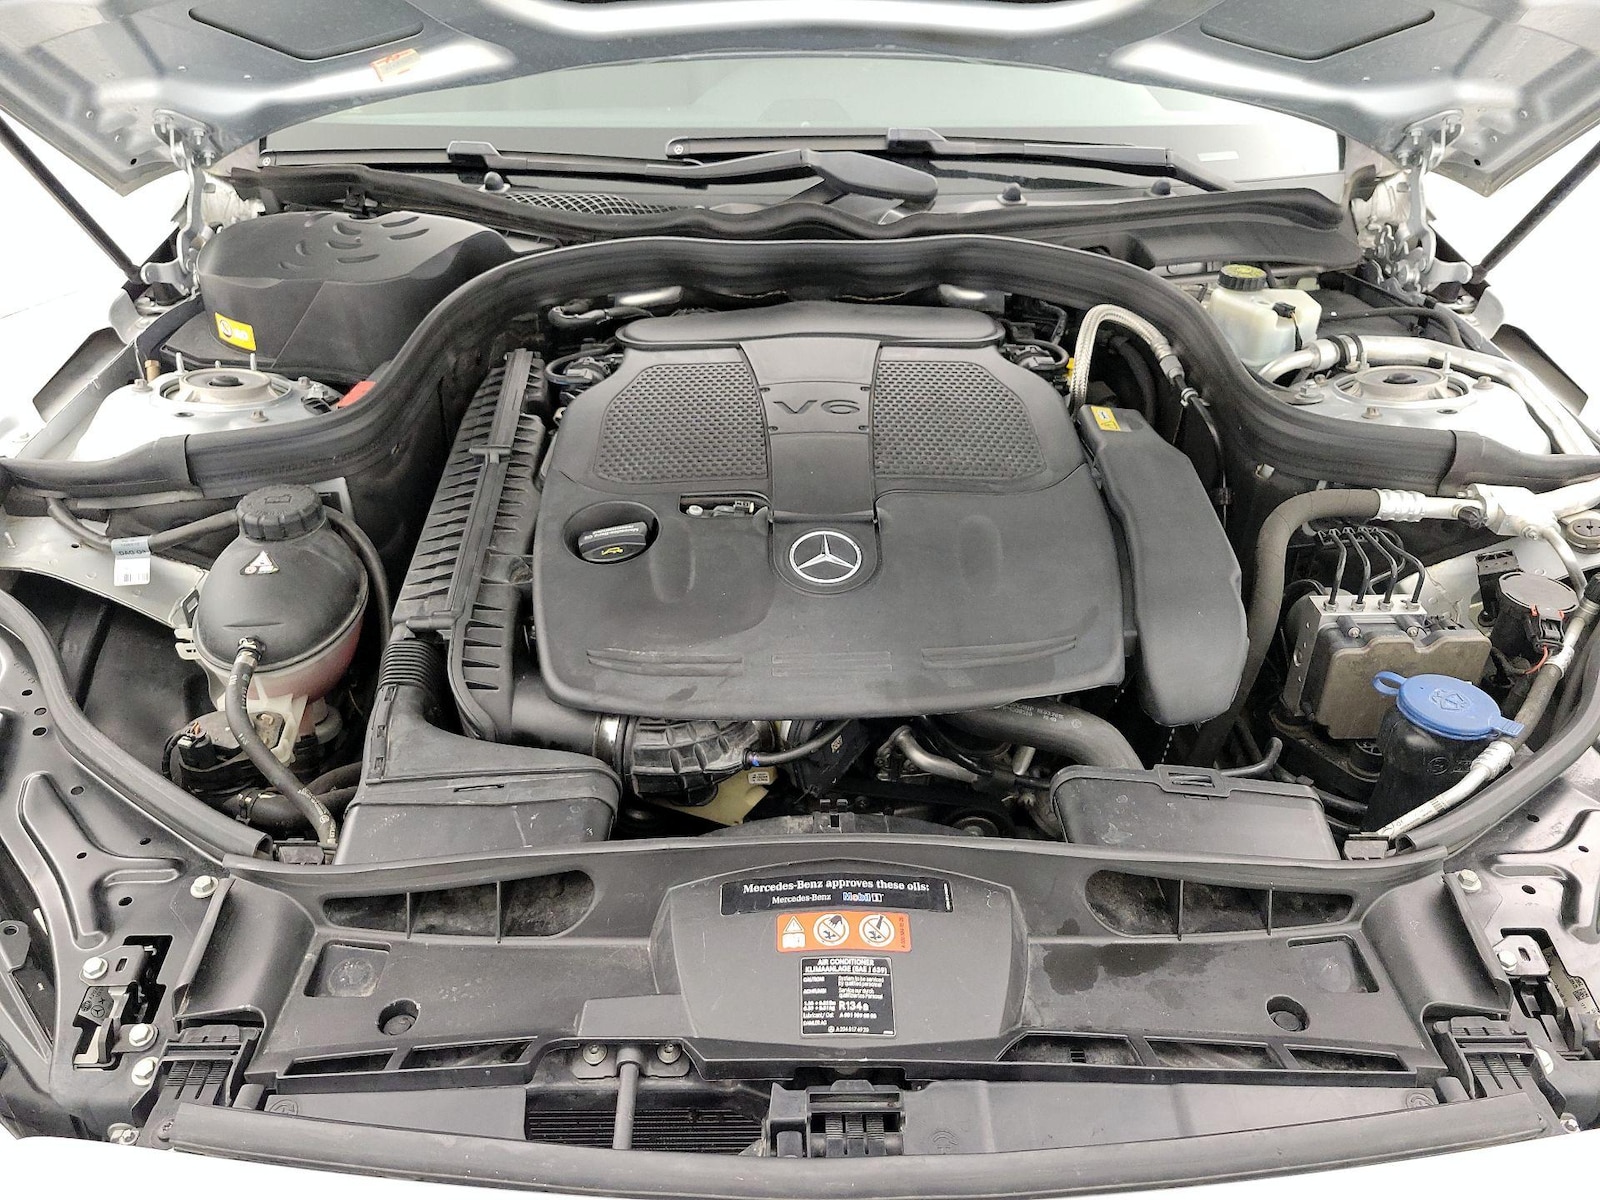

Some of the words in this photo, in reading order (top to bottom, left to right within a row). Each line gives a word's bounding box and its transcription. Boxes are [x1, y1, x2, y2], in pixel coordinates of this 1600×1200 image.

[773, 400, 860, 414] V6
[742, 879, 824, 894] Mercedes-Benz
[825, 879, 874, 891] approves
[875, 879, 905, 891] these
[907, 881, 930, 892] oils:
[771, 893, 832, 904] Mercedes-Benz
[842, 892, 871, 902] Mobil
[817, 958, 829, 966] AIR
[830, 958, 875, 966] CONDITIONER
